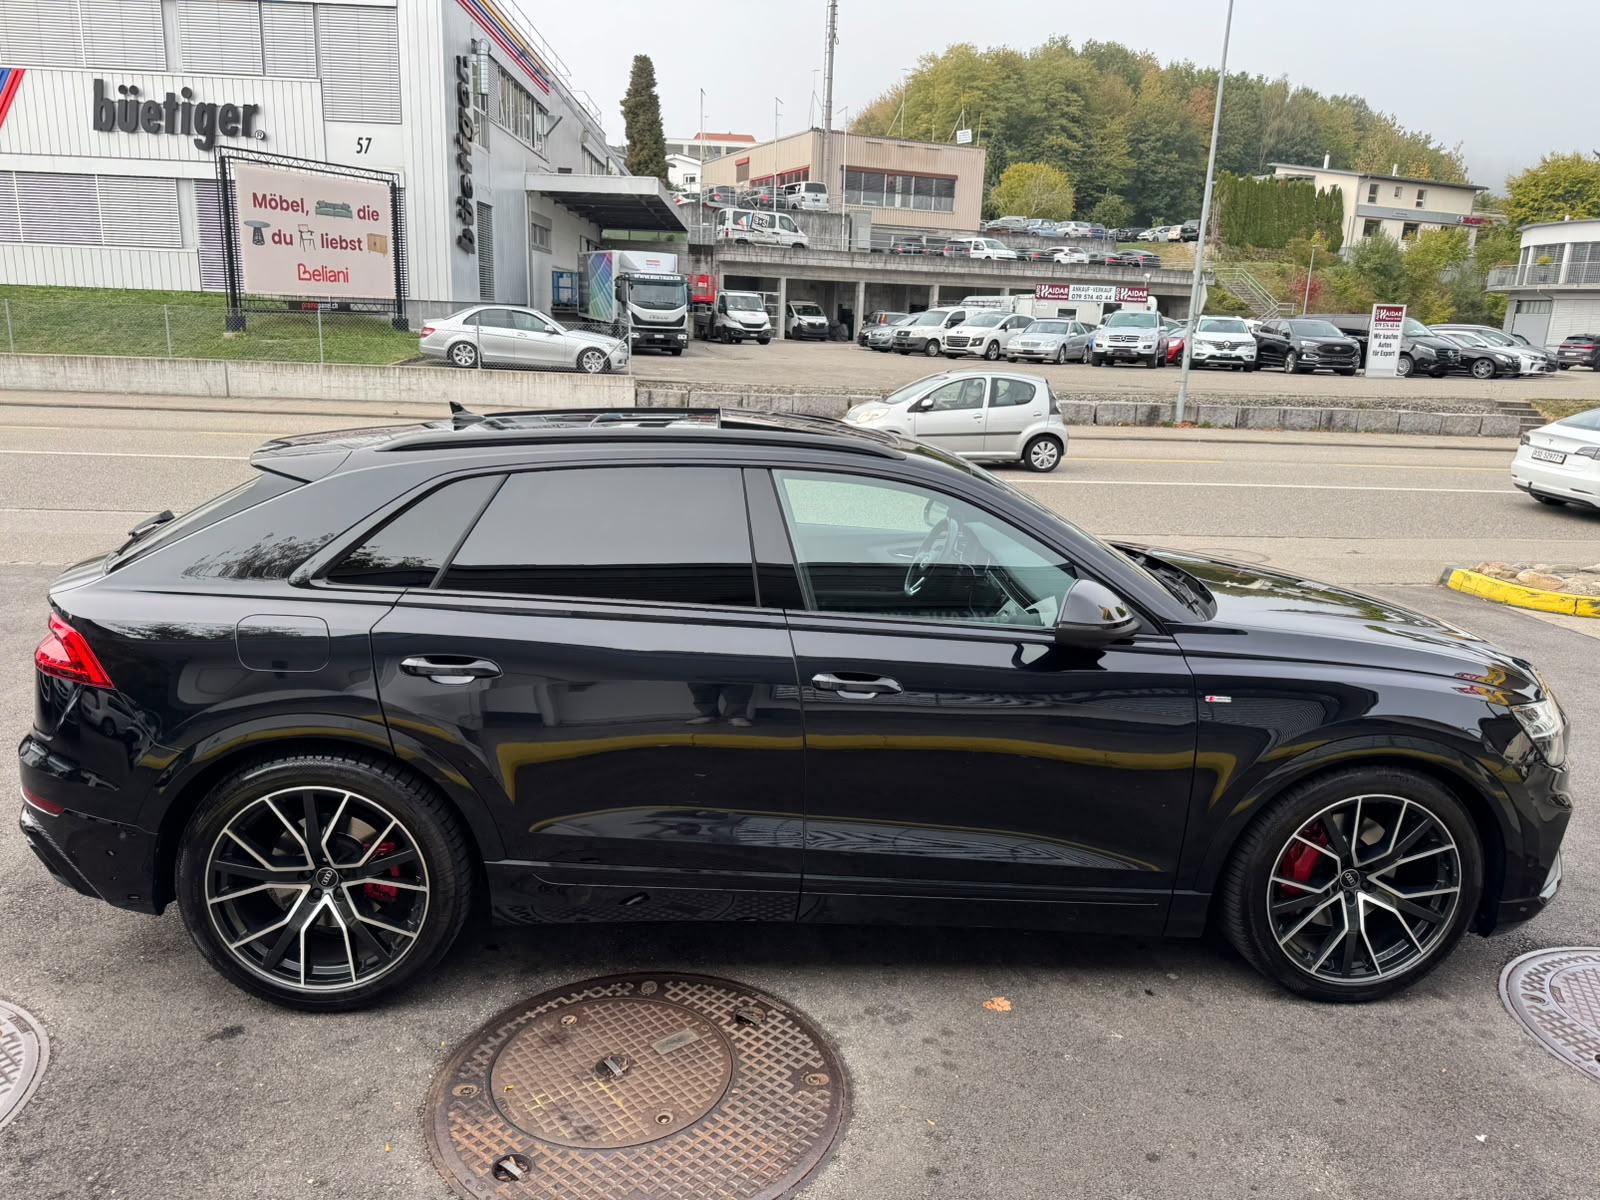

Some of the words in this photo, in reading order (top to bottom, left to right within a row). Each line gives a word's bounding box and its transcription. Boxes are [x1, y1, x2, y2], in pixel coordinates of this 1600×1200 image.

[93, 79, 259, 151] büetiger
[356, 136, 372, 154] 57
[252, 192, 310, 217] Möbel,
[356, 205, 380, 221] die
[271, 229, 294, 246] du
[320, 232, 364, 252] liebst
[297, 263, 350, 283] Beliani
